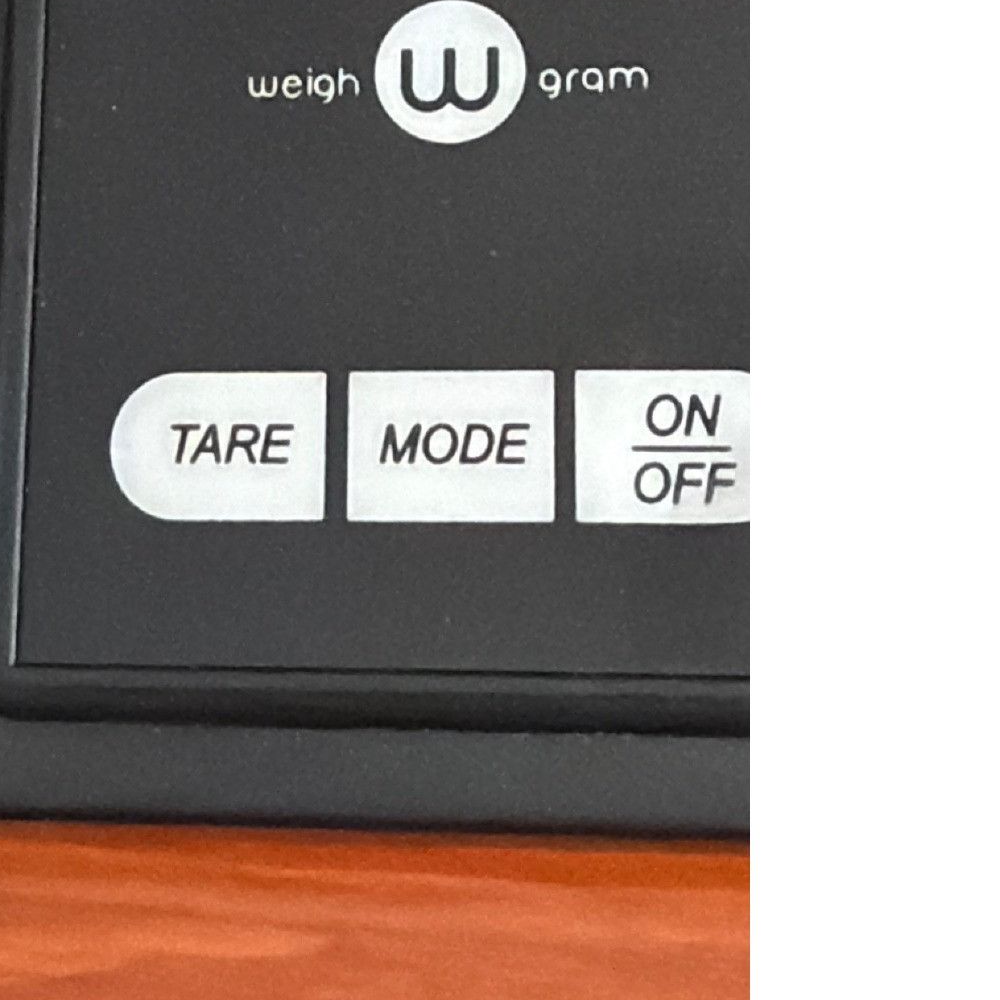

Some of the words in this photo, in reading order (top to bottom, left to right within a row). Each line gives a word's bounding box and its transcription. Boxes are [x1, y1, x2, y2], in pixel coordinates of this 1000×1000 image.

[247, 67, 361, 105] weigh
[538, 64, 651, 99] gram
[645, 392, 723, 438] ON
[169, 423, 296, 466] TARE
[379, 423, 532, 466] MODE
[632, 460, 738, 506] OFF
